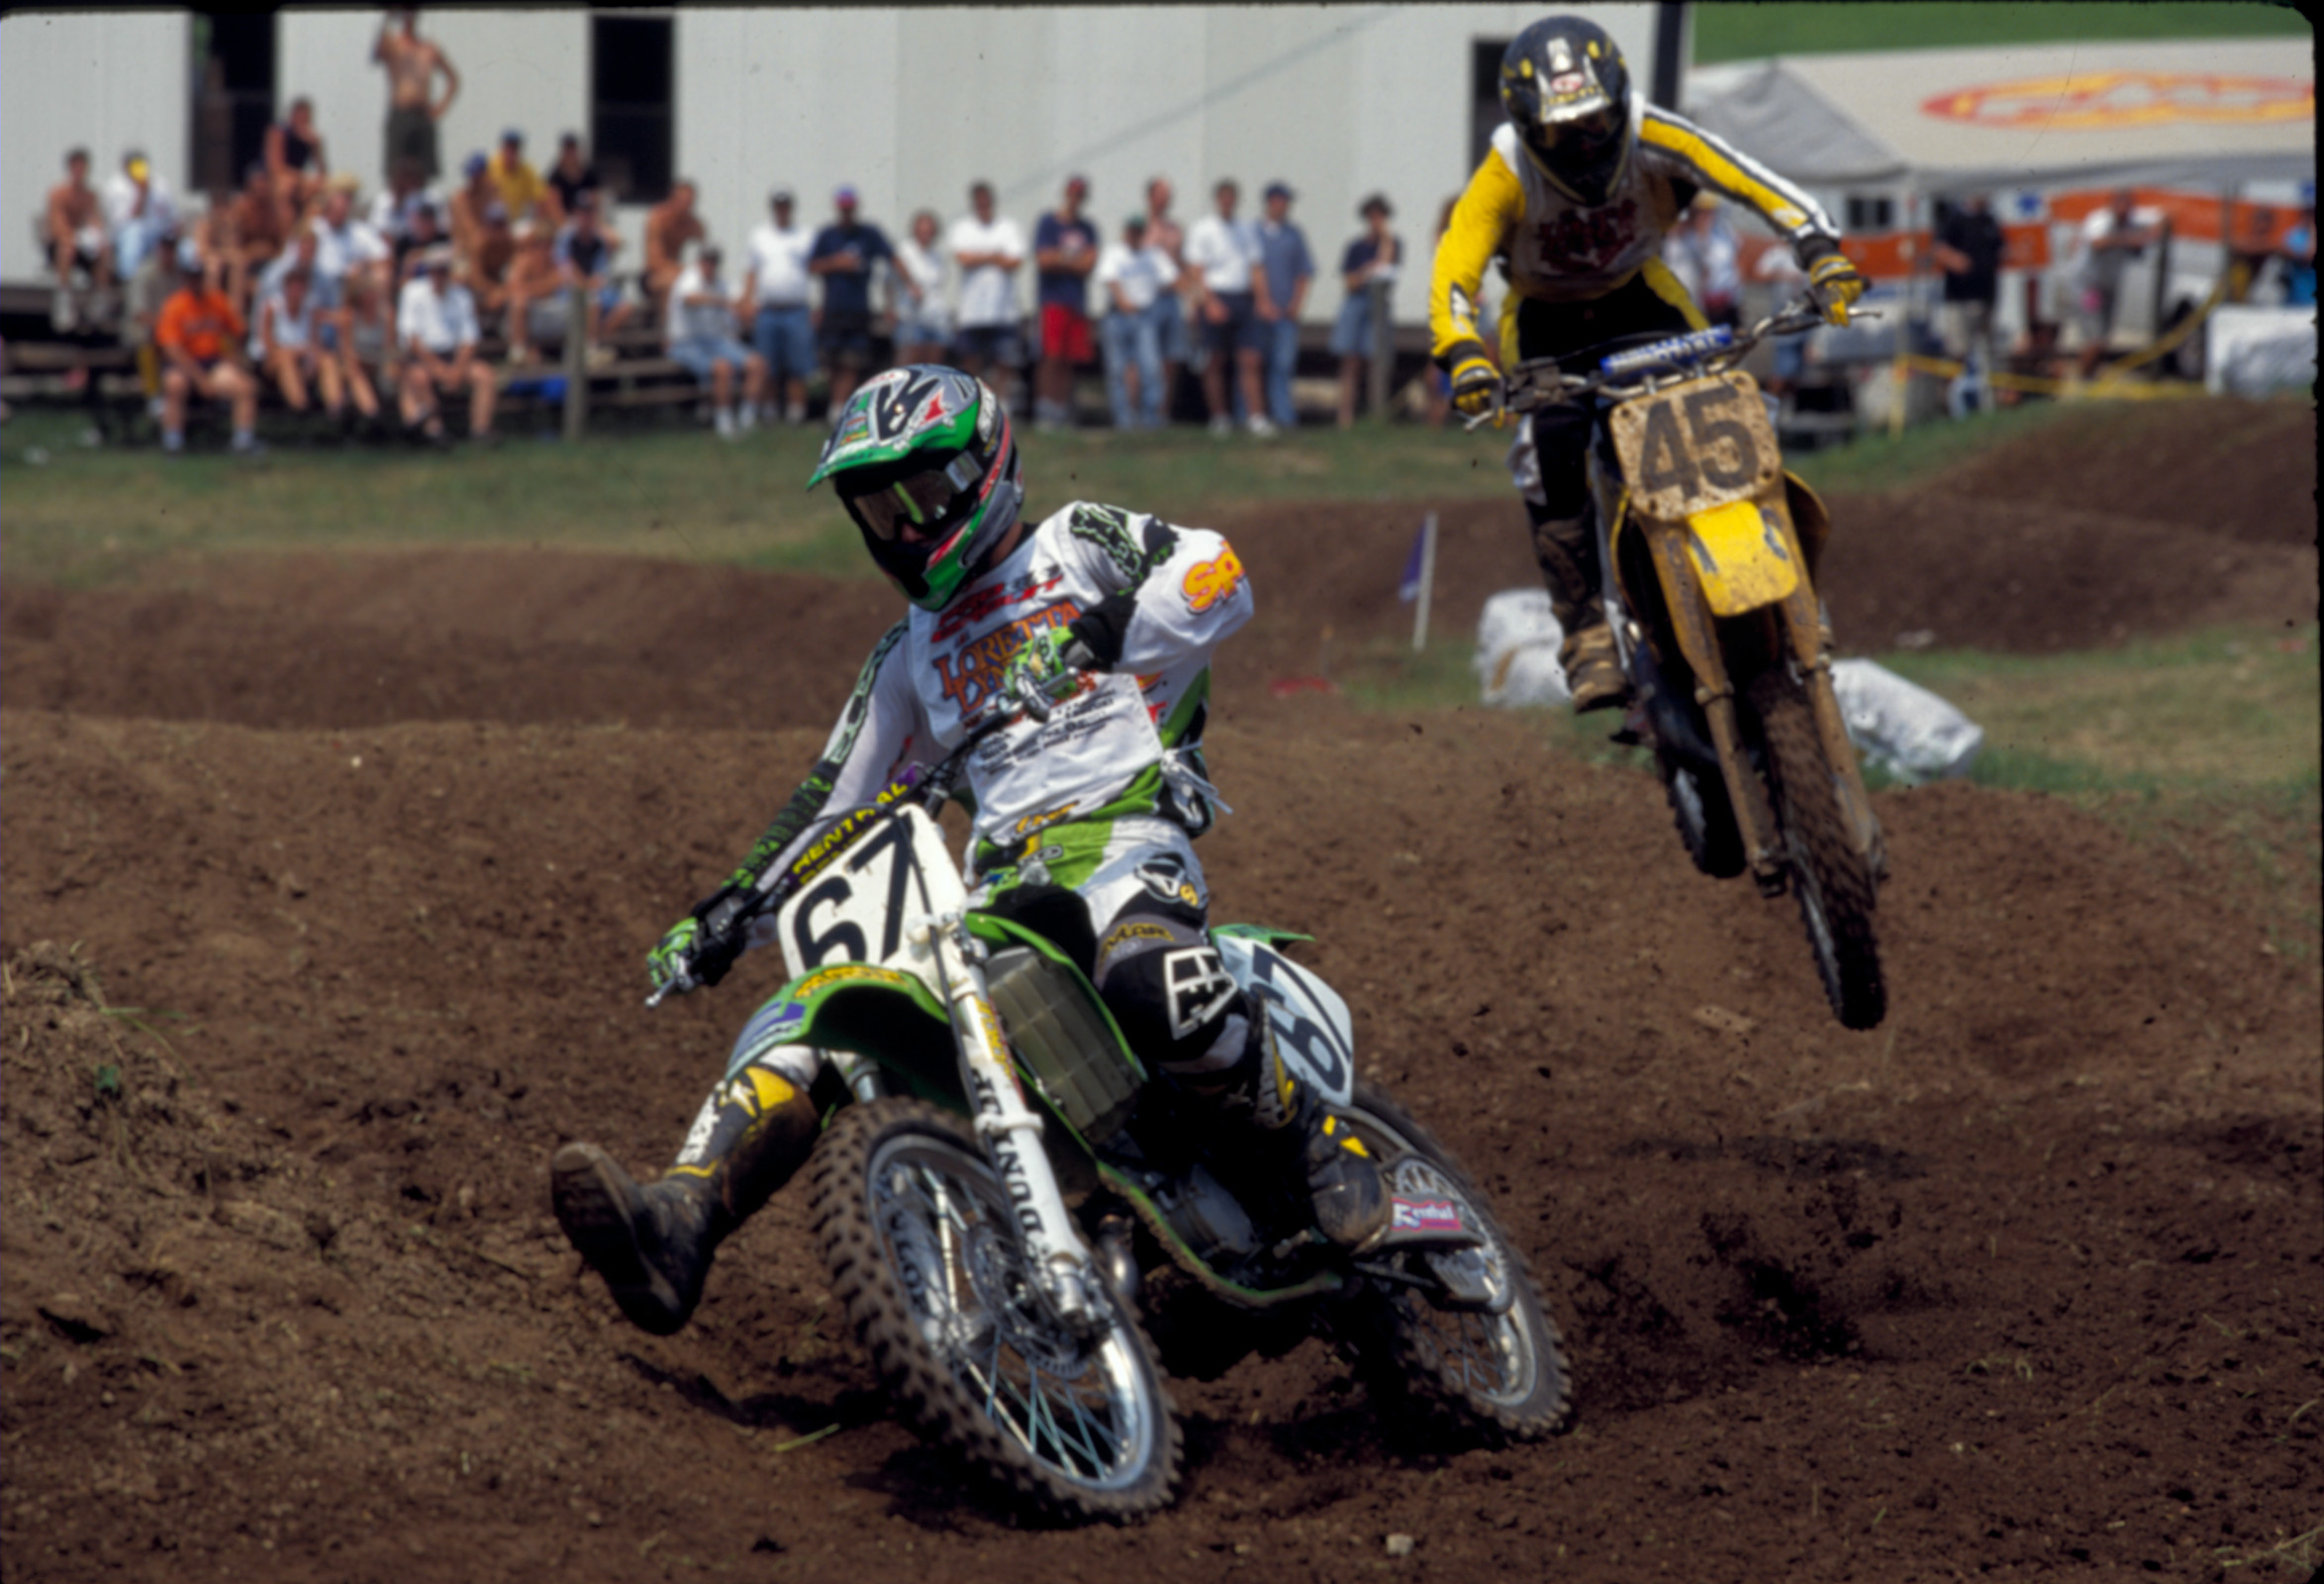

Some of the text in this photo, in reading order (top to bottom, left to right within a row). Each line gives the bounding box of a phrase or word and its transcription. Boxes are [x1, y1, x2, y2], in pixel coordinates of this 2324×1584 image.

[1639, 384, 1760, 497] 45
[931, 598, 1083, 701] LORETTA
[792, 810, 917, 969] 67
